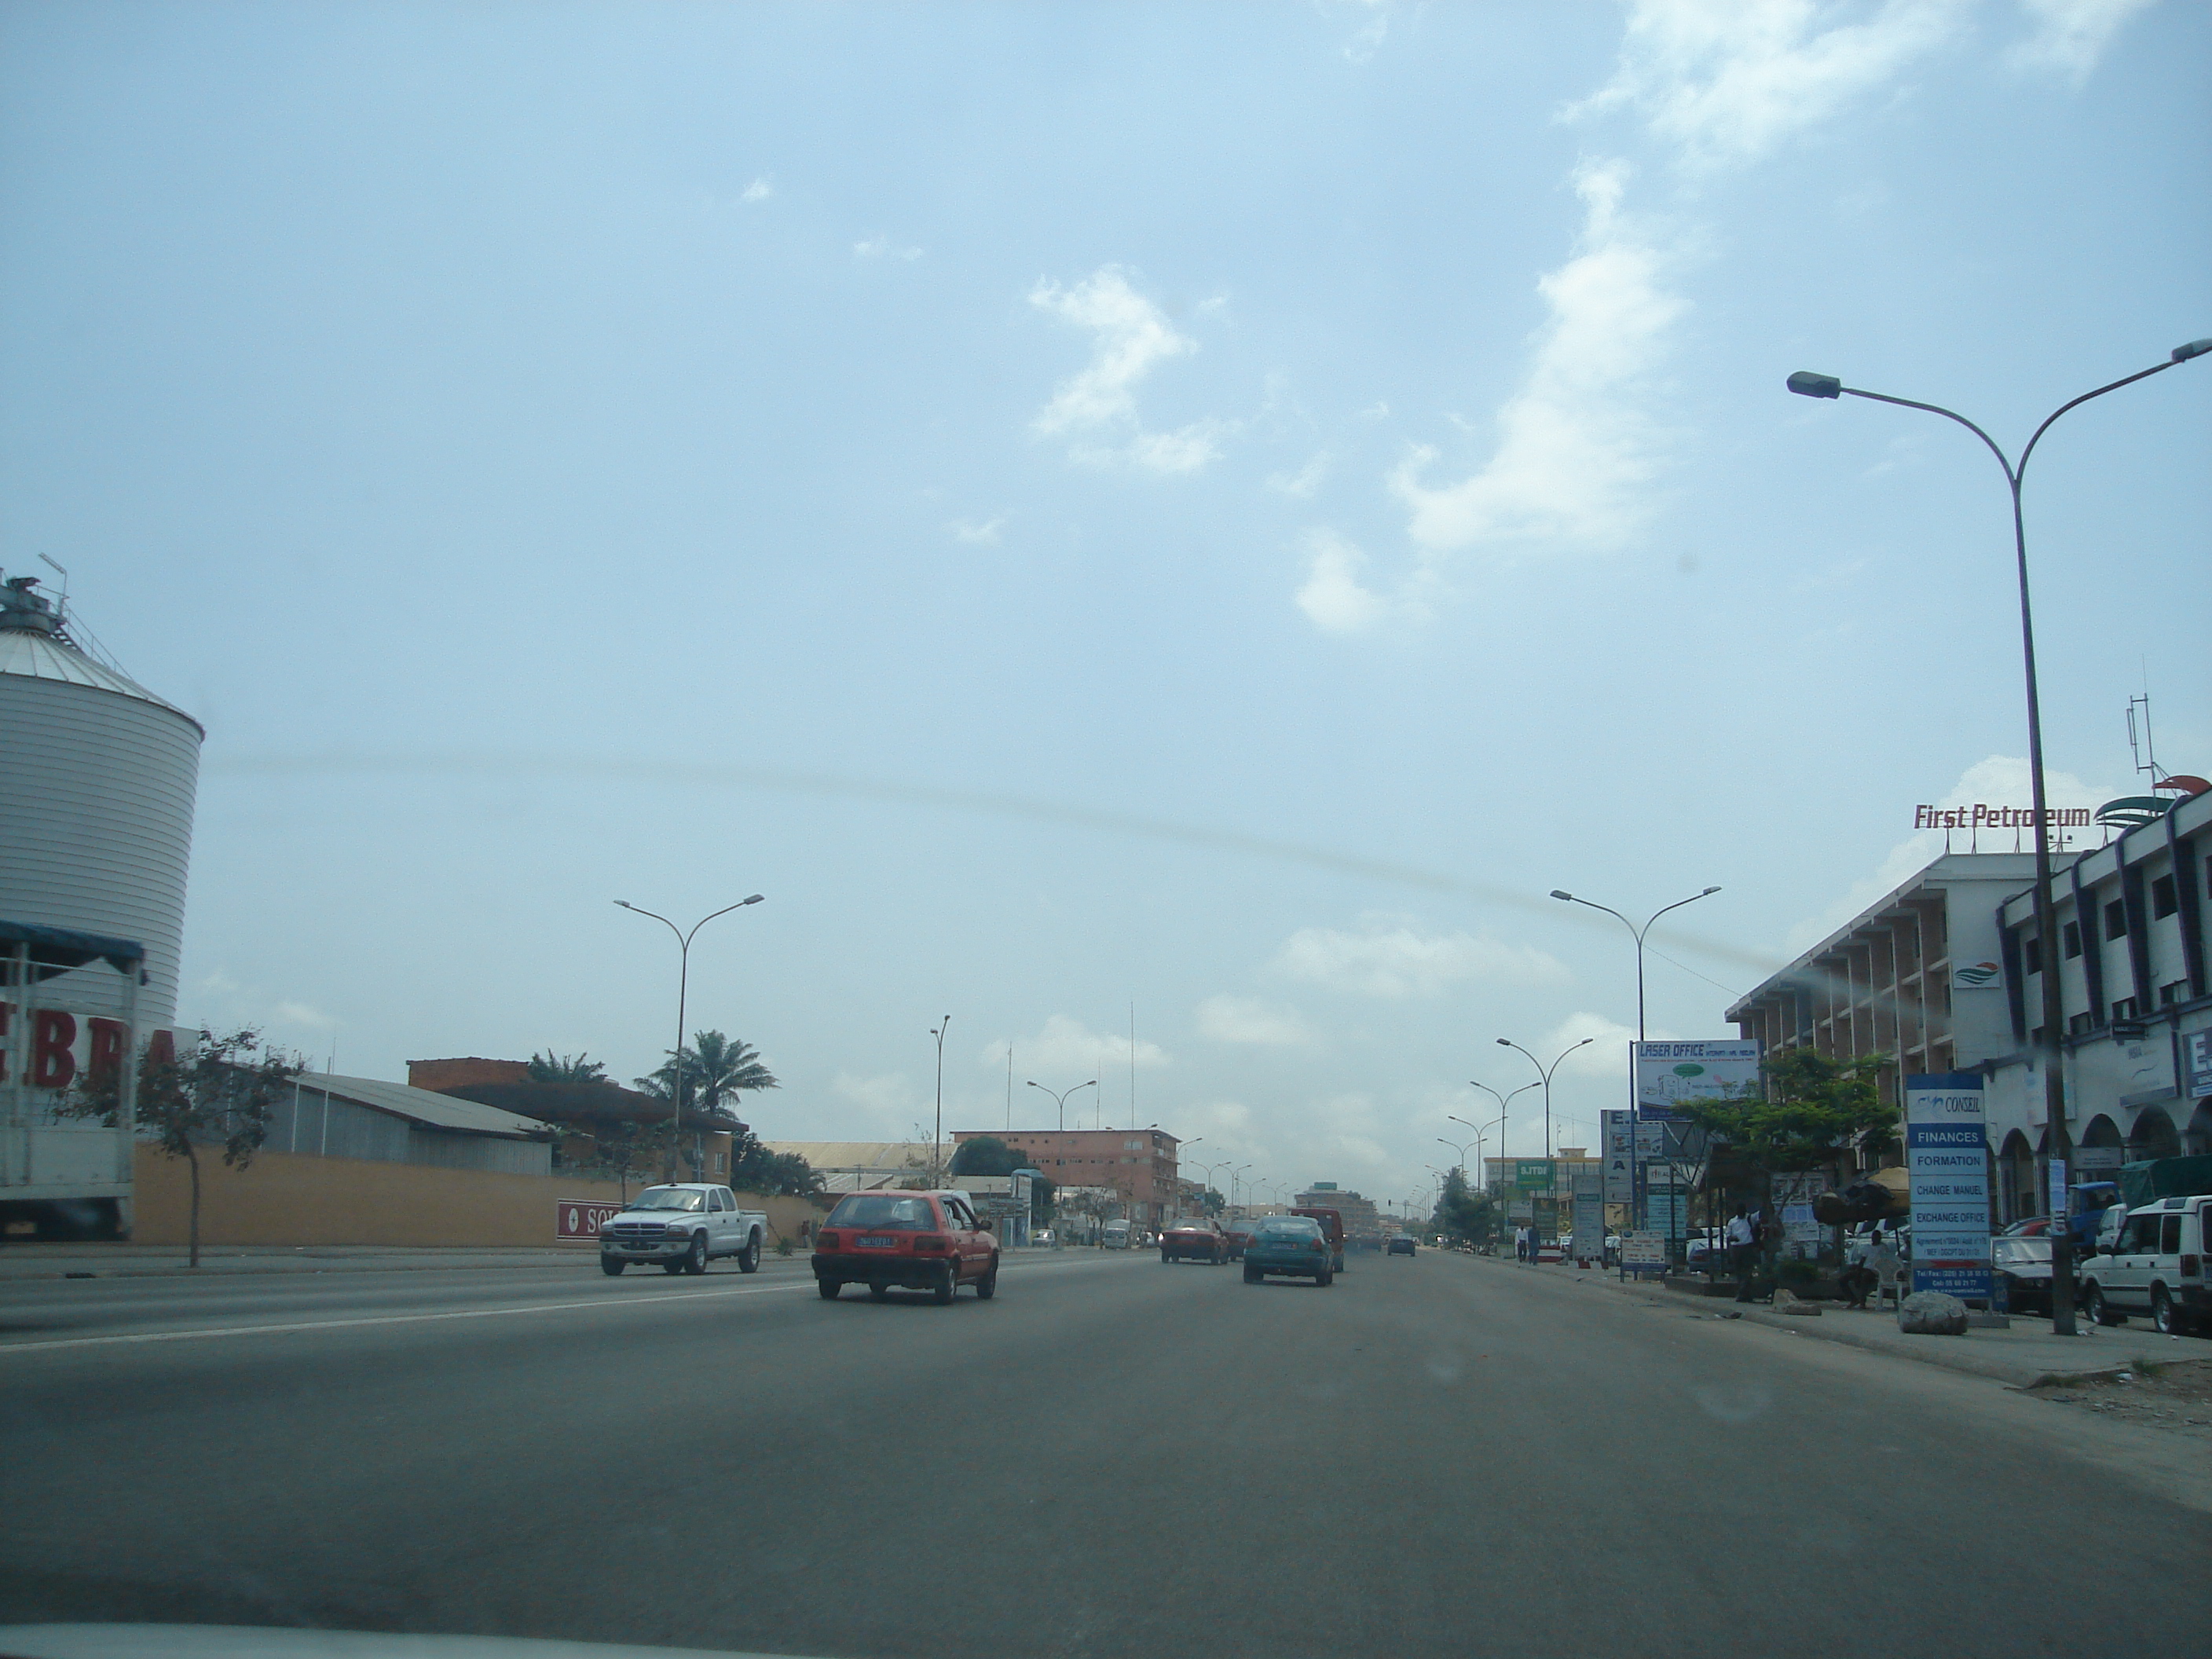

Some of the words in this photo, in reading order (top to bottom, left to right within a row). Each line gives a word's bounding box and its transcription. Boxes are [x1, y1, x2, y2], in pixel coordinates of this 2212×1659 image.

[1914, 804, 1968, 829] First
[1972, 804, 2089, 828] Petroeum
[1639, 1043, 1671, 1057] LASER
[1672, 1043, 1705, 1057] OFFICE
[1945, 1097, 1980, 1113] CONSEIL
[1917, 1132, 1979, 1143] FINANCES
[1917, 1155, 1980, 1166] FORMATION
[1917, 1185, 1950, 1195] CHANGE
[1953, 1185, 1983, 1195] MANUEL
[1917, 1213, 1959, 1223] EXCHANGE
[1960, 1213, 1985, 1222] OFFICE
